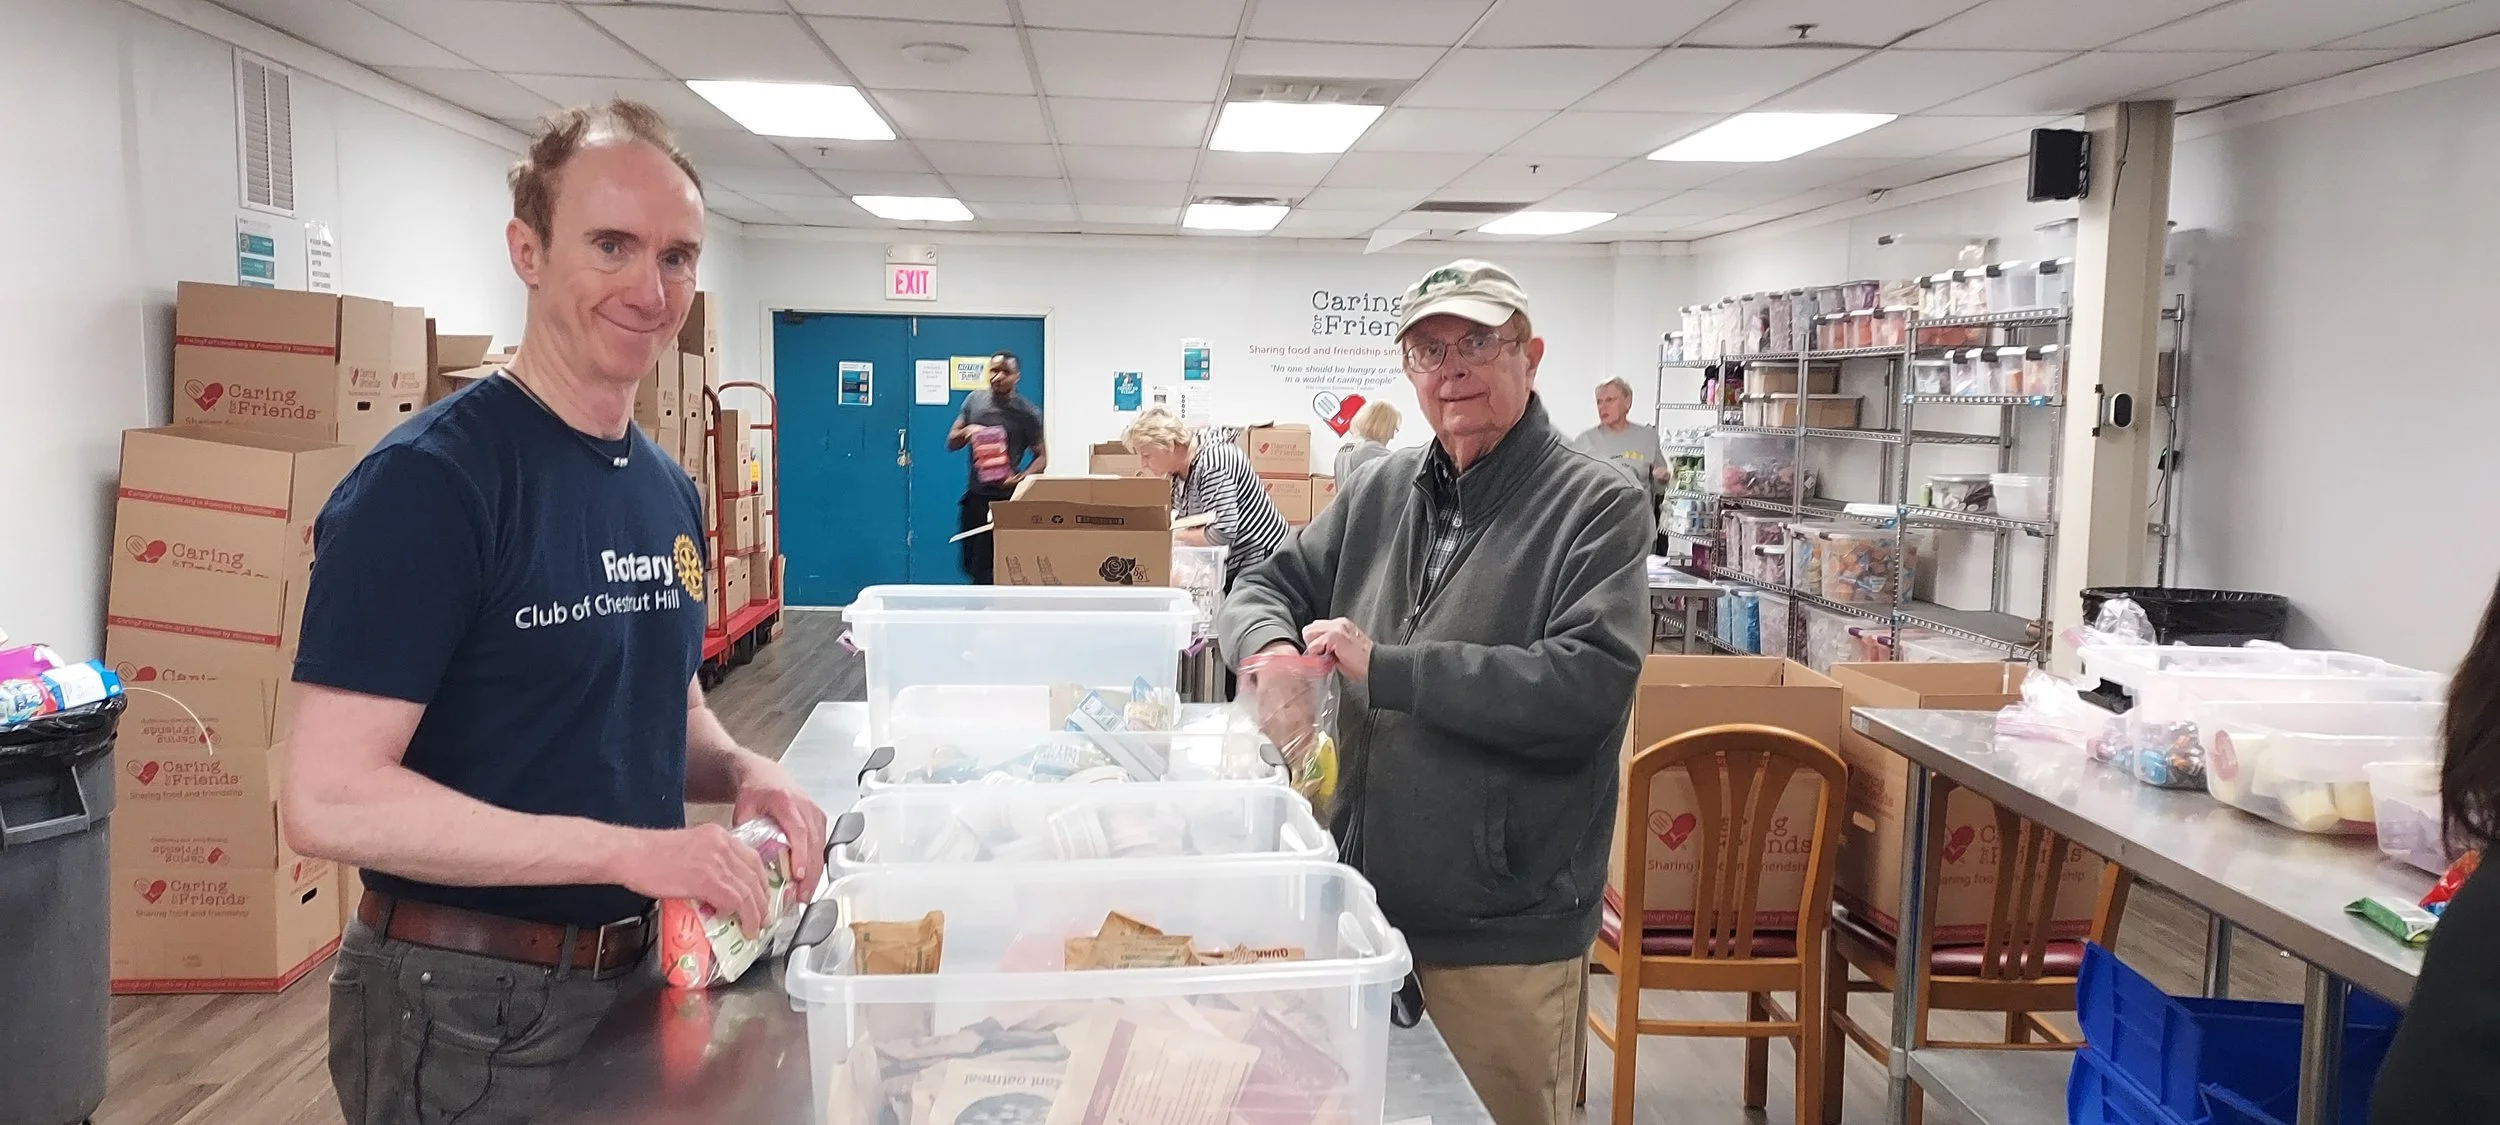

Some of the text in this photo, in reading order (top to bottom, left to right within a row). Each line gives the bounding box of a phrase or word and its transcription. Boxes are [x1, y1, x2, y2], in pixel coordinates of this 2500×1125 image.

[895, 269, 928, 294] EXIT
[1312, 290, 1403, 317] Caring
[1312, 314, 1322, 335] for
[1325, 315, 1399, 336] Frien
[1249, 345, 1285, 357] Sharing
[1288, 345, 1310, 355] food
[1313, 345, 1330, 355] and
[1333, 346, 1381, 357] friendship
[1305, 364, 1333, 373] should
[1335, 364, 1346, 374] be
[1348, 364, 1376, 376] hungry
[1285, 375, 1292, 383] in
[1302, 375, 1325, 384] world
[1327, 375, 1335, 384] of
[1337, 376, 1363, 386] caring
[228, 384, 297, 406] Caring
[238, 401, 318, 420] Friends
[172, 542, 244, 569] Caring
[600, 550, 674, 586] Rotary
[515, 601, 568, 629] Club
[572, 595, 591, 621] of
[655, 588, 680, 610] Hill
[163, 760, 221, 774] Caring
[173, 773, 239, 787] Friends
[130, 792, 161, 801] Sharing
[202, 790, 243, 798] friendship
[1648, 860, 1694, 873] Sharing
[171, 880, 227, 895] Caring
[179, 893, 246, 906] Friends
[963, 1074, 1028, 1088] oatmeal
